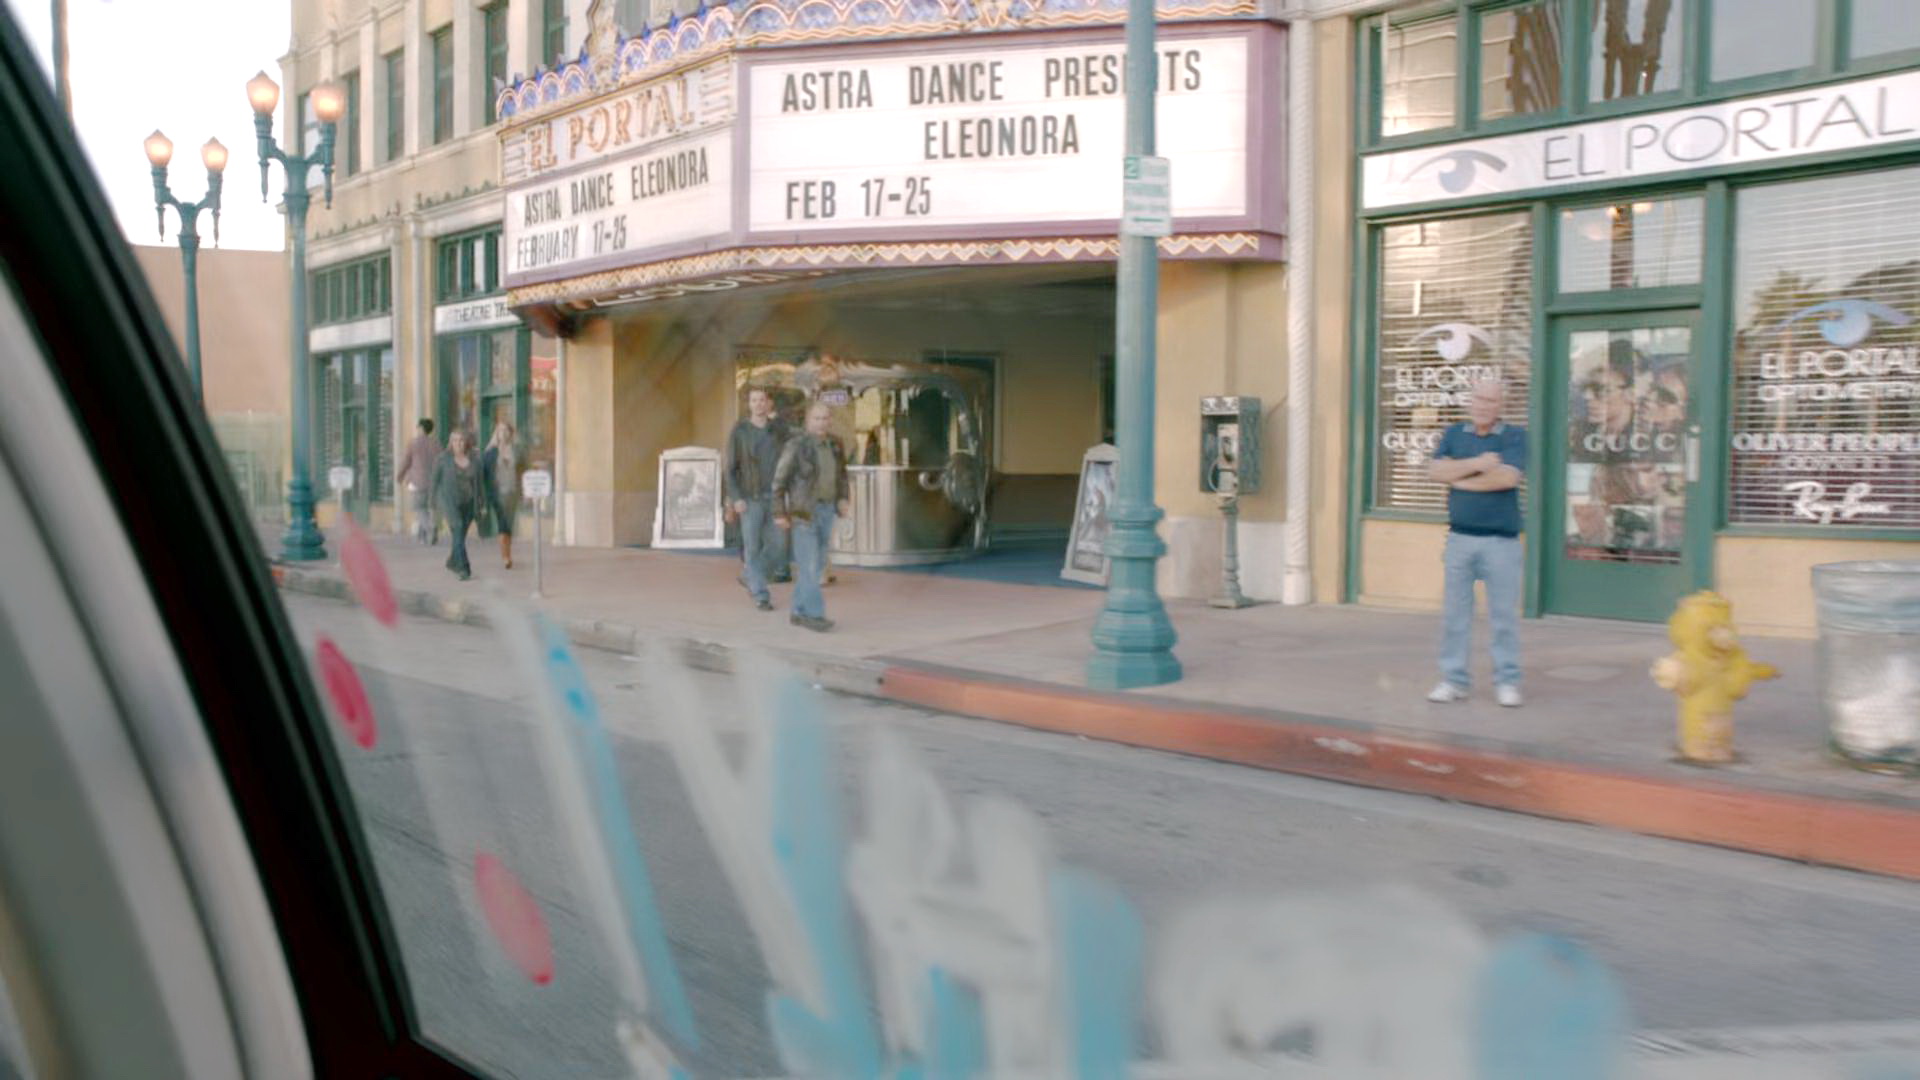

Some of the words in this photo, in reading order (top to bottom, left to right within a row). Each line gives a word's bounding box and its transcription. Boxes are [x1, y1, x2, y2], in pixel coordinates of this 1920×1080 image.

[781, 69, 873, 112] ASTRA
[909, 61, 1003, 105] DANCE
[1045, 49, 1200, 98] PRESTS
[529, 120, 557, 171] EL
[569, 78, 695, 160] PORTAL
[924, 114, 1079, 160] ELEONORA
[1544, 134, 1605, 180] EL
[1625, 86, 1916, 170] PORTAL
[524, 188, 562, 228] ASTRA
[571, 172, 614, 216] DANCE
[631, 147, 709, 201] ELEONORA
[786, 180, 836, 220] FEB
[860, 176, 931, 217] 17-25
[516, 224, 579, 270] FEBRUARY
[592, 214, 627, 254] 17-25
[1396, 369, 1420, 391] EL
[1761, 352, 1791, 379] EL
[1395, 392, 1473, 407] OPTOME
[1382, 432, 1443, 450] GUCC
[1583, 433, 1683, 452] GUCC
